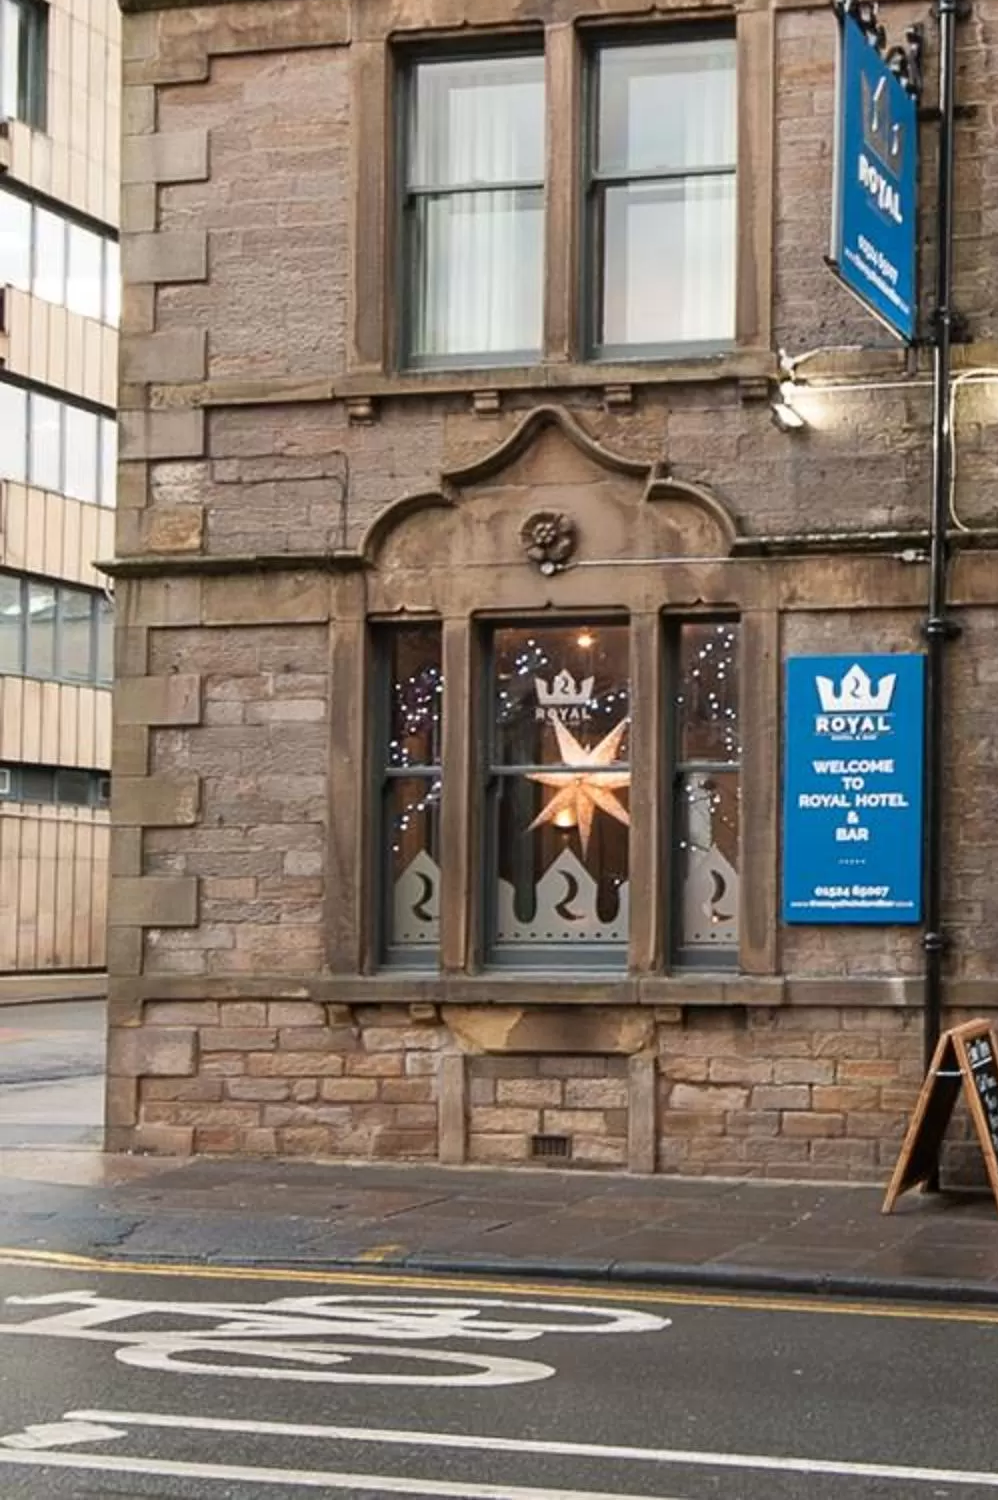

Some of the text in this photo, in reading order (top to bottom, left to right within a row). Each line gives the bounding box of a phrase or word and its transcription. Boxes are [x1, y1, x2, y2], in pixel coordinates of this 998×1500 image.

[858, 153, 903, 224] ROYAL
[535, 706, 592, 721] ROYAL
[815, 716, 891, 734] ROYAL
[812, 759, 894, 774] WELCOME
[841, 777, 865, 790] TO
[799, 792, 909, 808] ROYAL HOTEL
[847, 810, 859, 824] &
[835, 827, 869, 841] BAR
